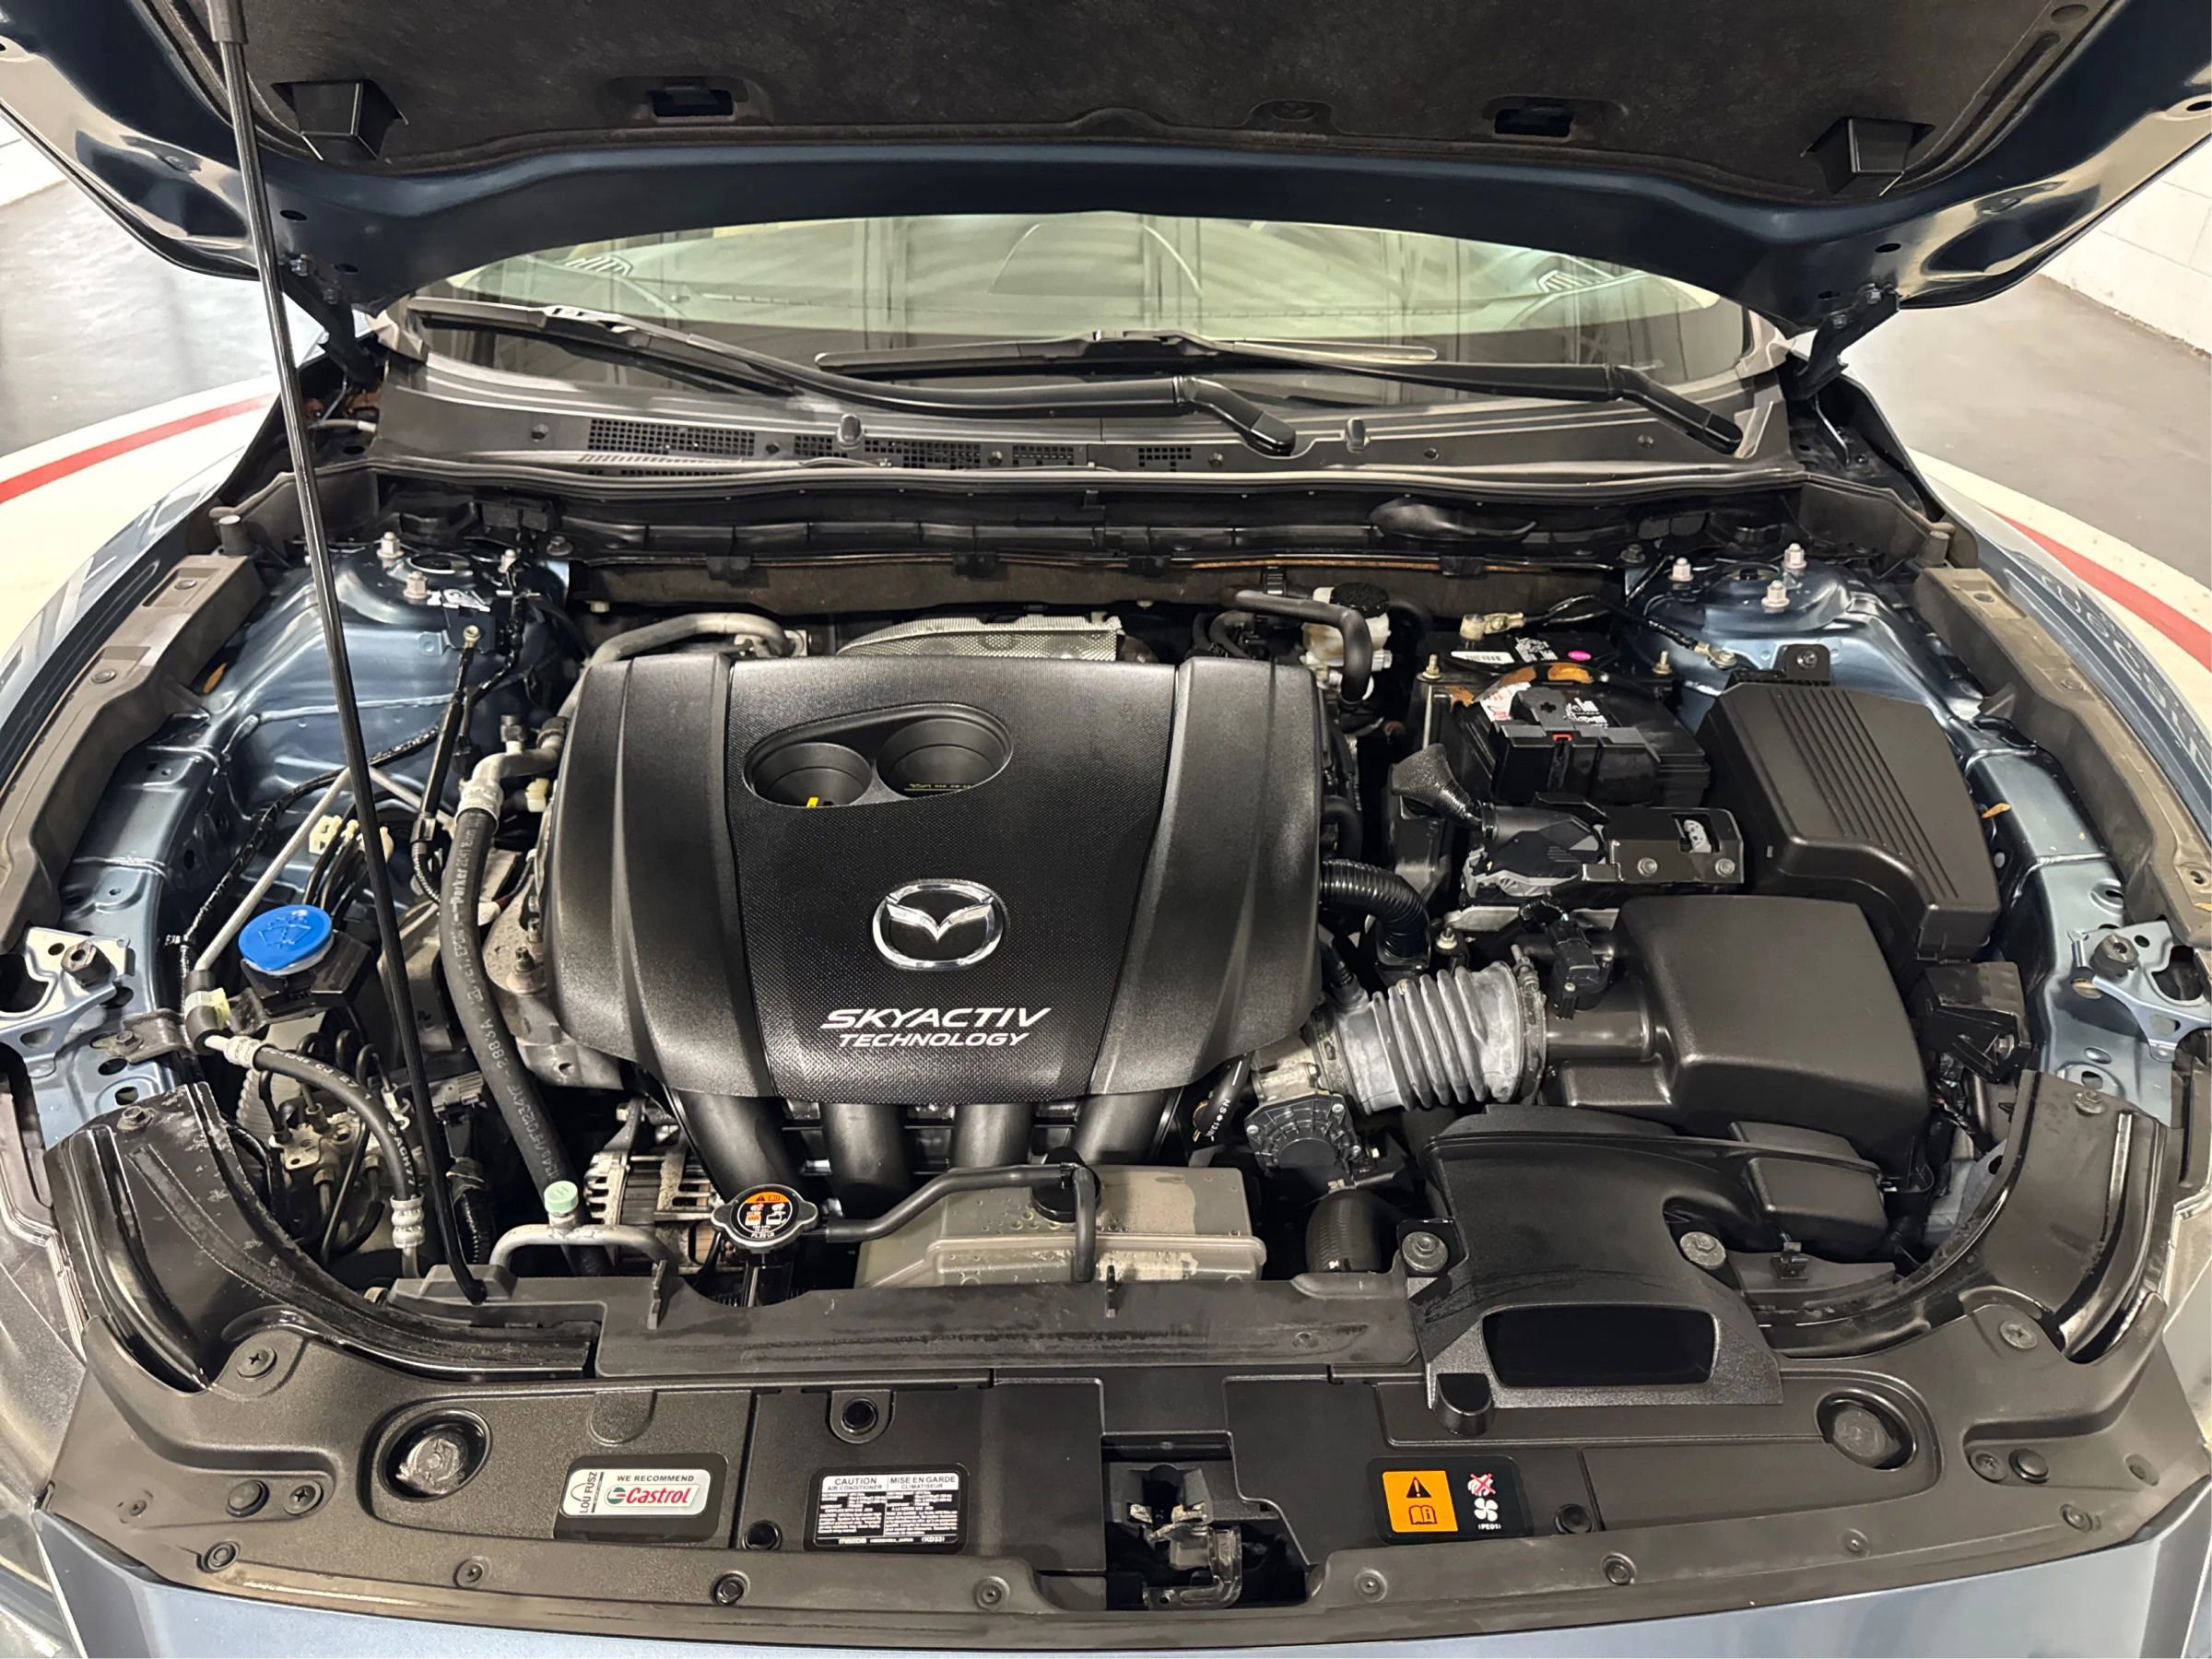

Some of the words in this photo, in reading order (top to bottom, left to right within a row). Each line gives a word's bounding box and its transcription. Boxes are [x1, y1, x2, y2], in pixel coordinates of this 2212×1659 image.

[450, 869, 469, 904] Parker
[819, 1007, 1052, 1029] SKYACTIV
[839, 1032, 1030, 1047] TECHNOLOGY
[584, 1471, 598, 1494] FUSZ
[834, 1477, 877, 1486] CAUTION
[626, 1487, 692, 1504] Castrol
[579, 1496, 592, 1513] LOU
